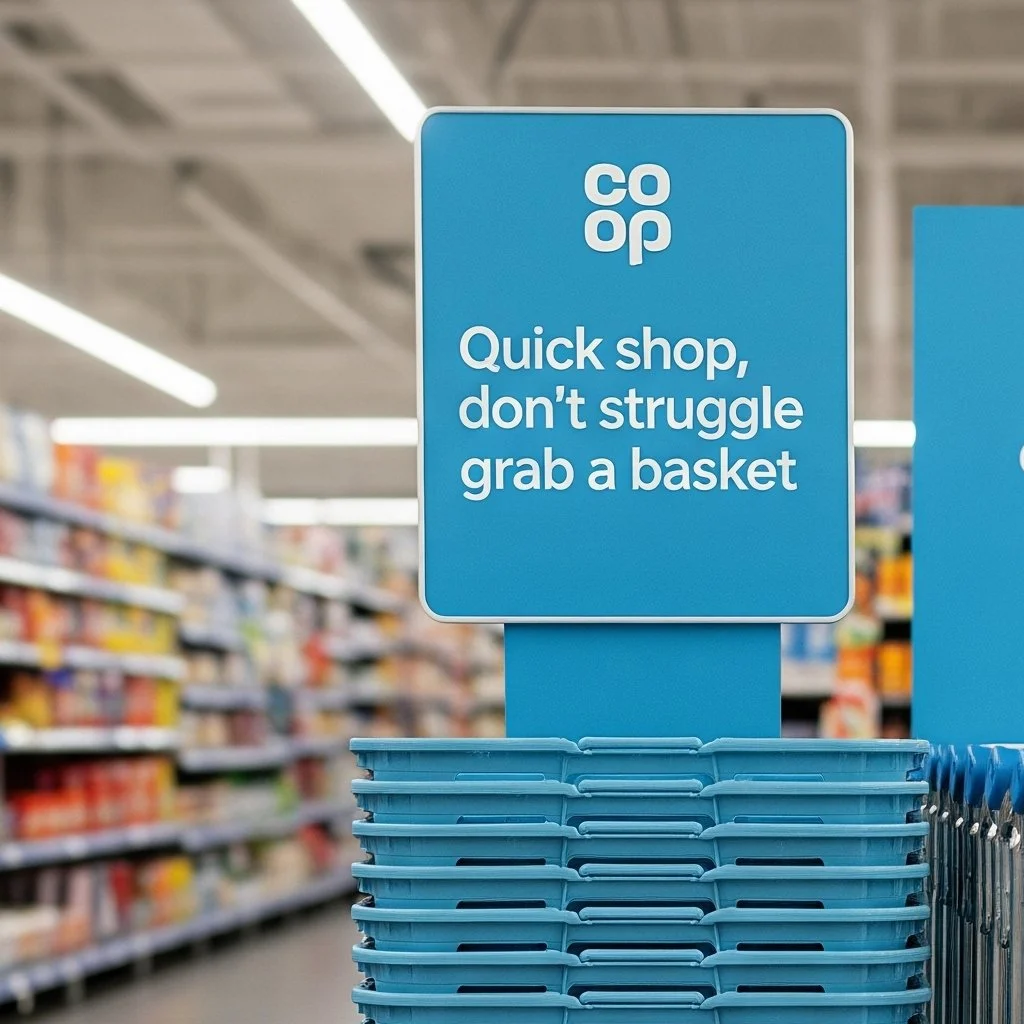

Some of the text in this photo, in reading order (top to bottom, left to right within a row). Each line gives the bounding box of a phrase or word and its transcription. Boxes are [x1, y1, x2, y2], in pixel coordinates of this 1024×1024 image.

[459, 325, 749, 381] Quick shop,
[598, 385, 804, 441] struggle
[460, 446, 798, 501] grab a basket
